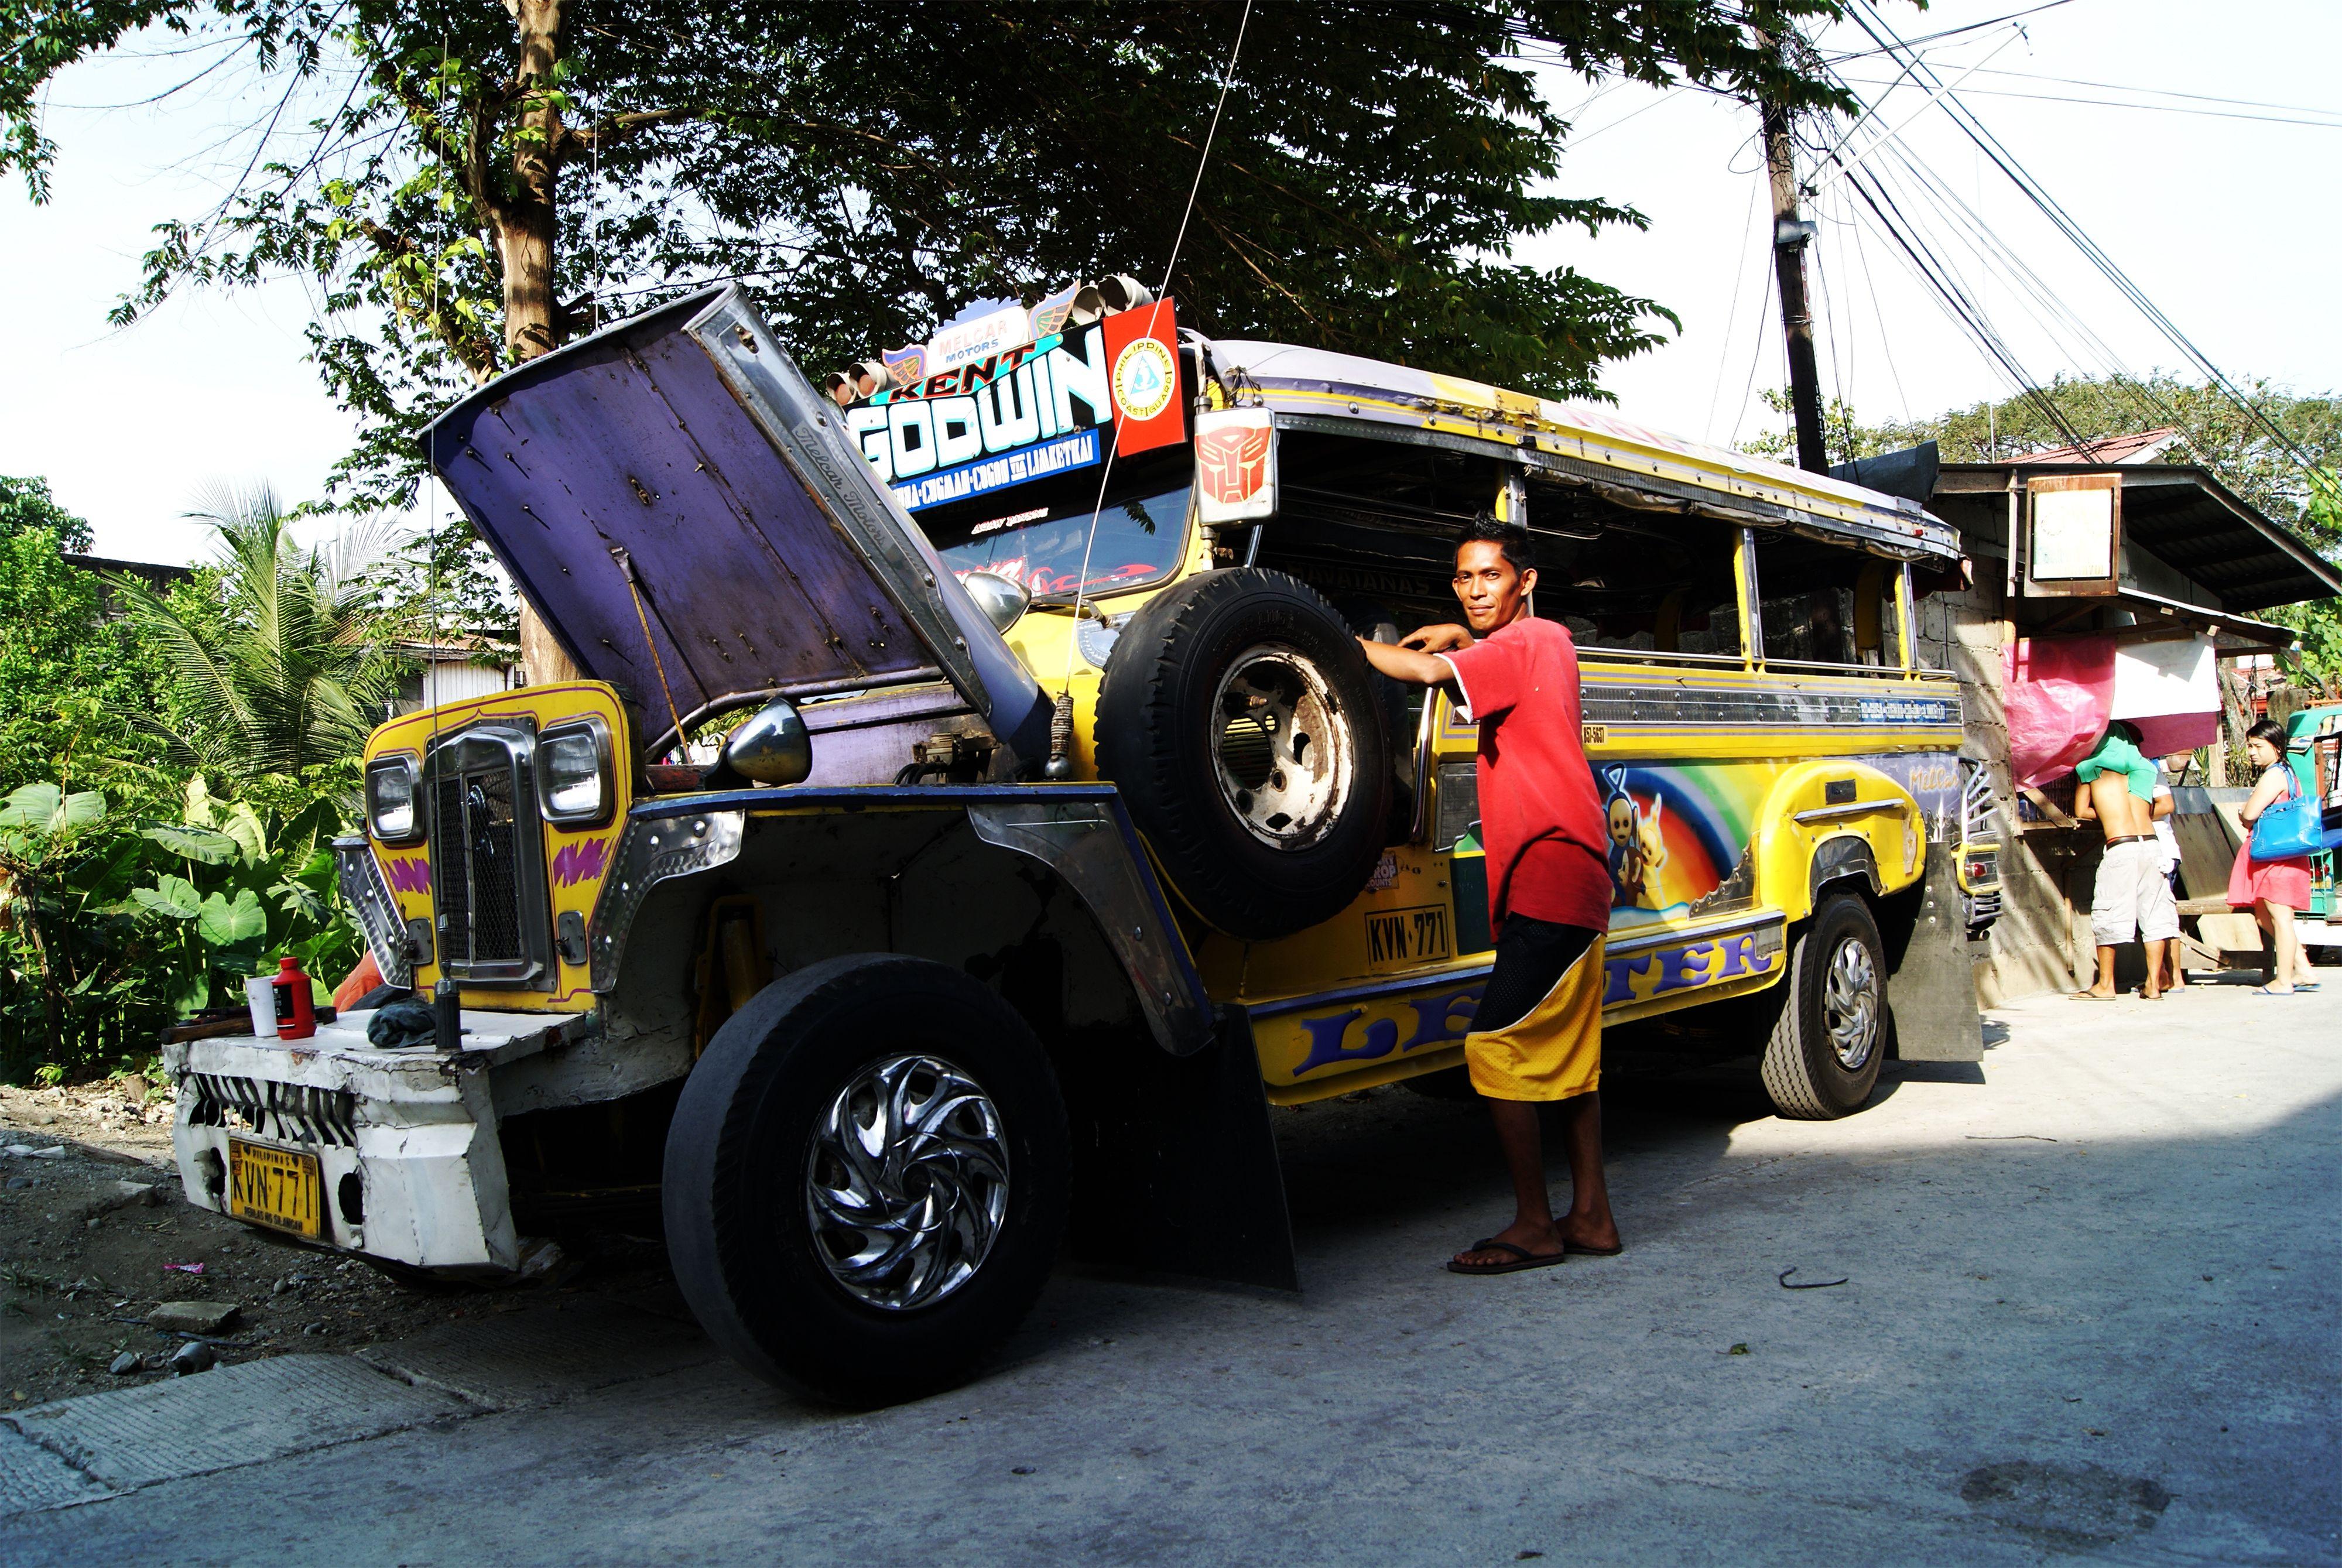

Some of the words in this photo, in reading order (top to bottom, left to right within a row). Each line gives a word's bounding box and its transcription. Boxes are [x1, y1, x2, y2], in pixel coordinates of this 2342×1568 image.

[939, 320, 1007, 356] MELCAR
[946, 338, 999, 364] MOTORS
[847, 324, 1114, 482] GODWIN
[888, 341, 1036, 403] KENT
[1117, 389, 1143, 416] COAST
[1149, 376, 1172, 413] GUARD
[795, 427, 843, 490] Melcar
[843, 491, 885, 547] Motors
[1292, 933, 1773, 1077] LETER
